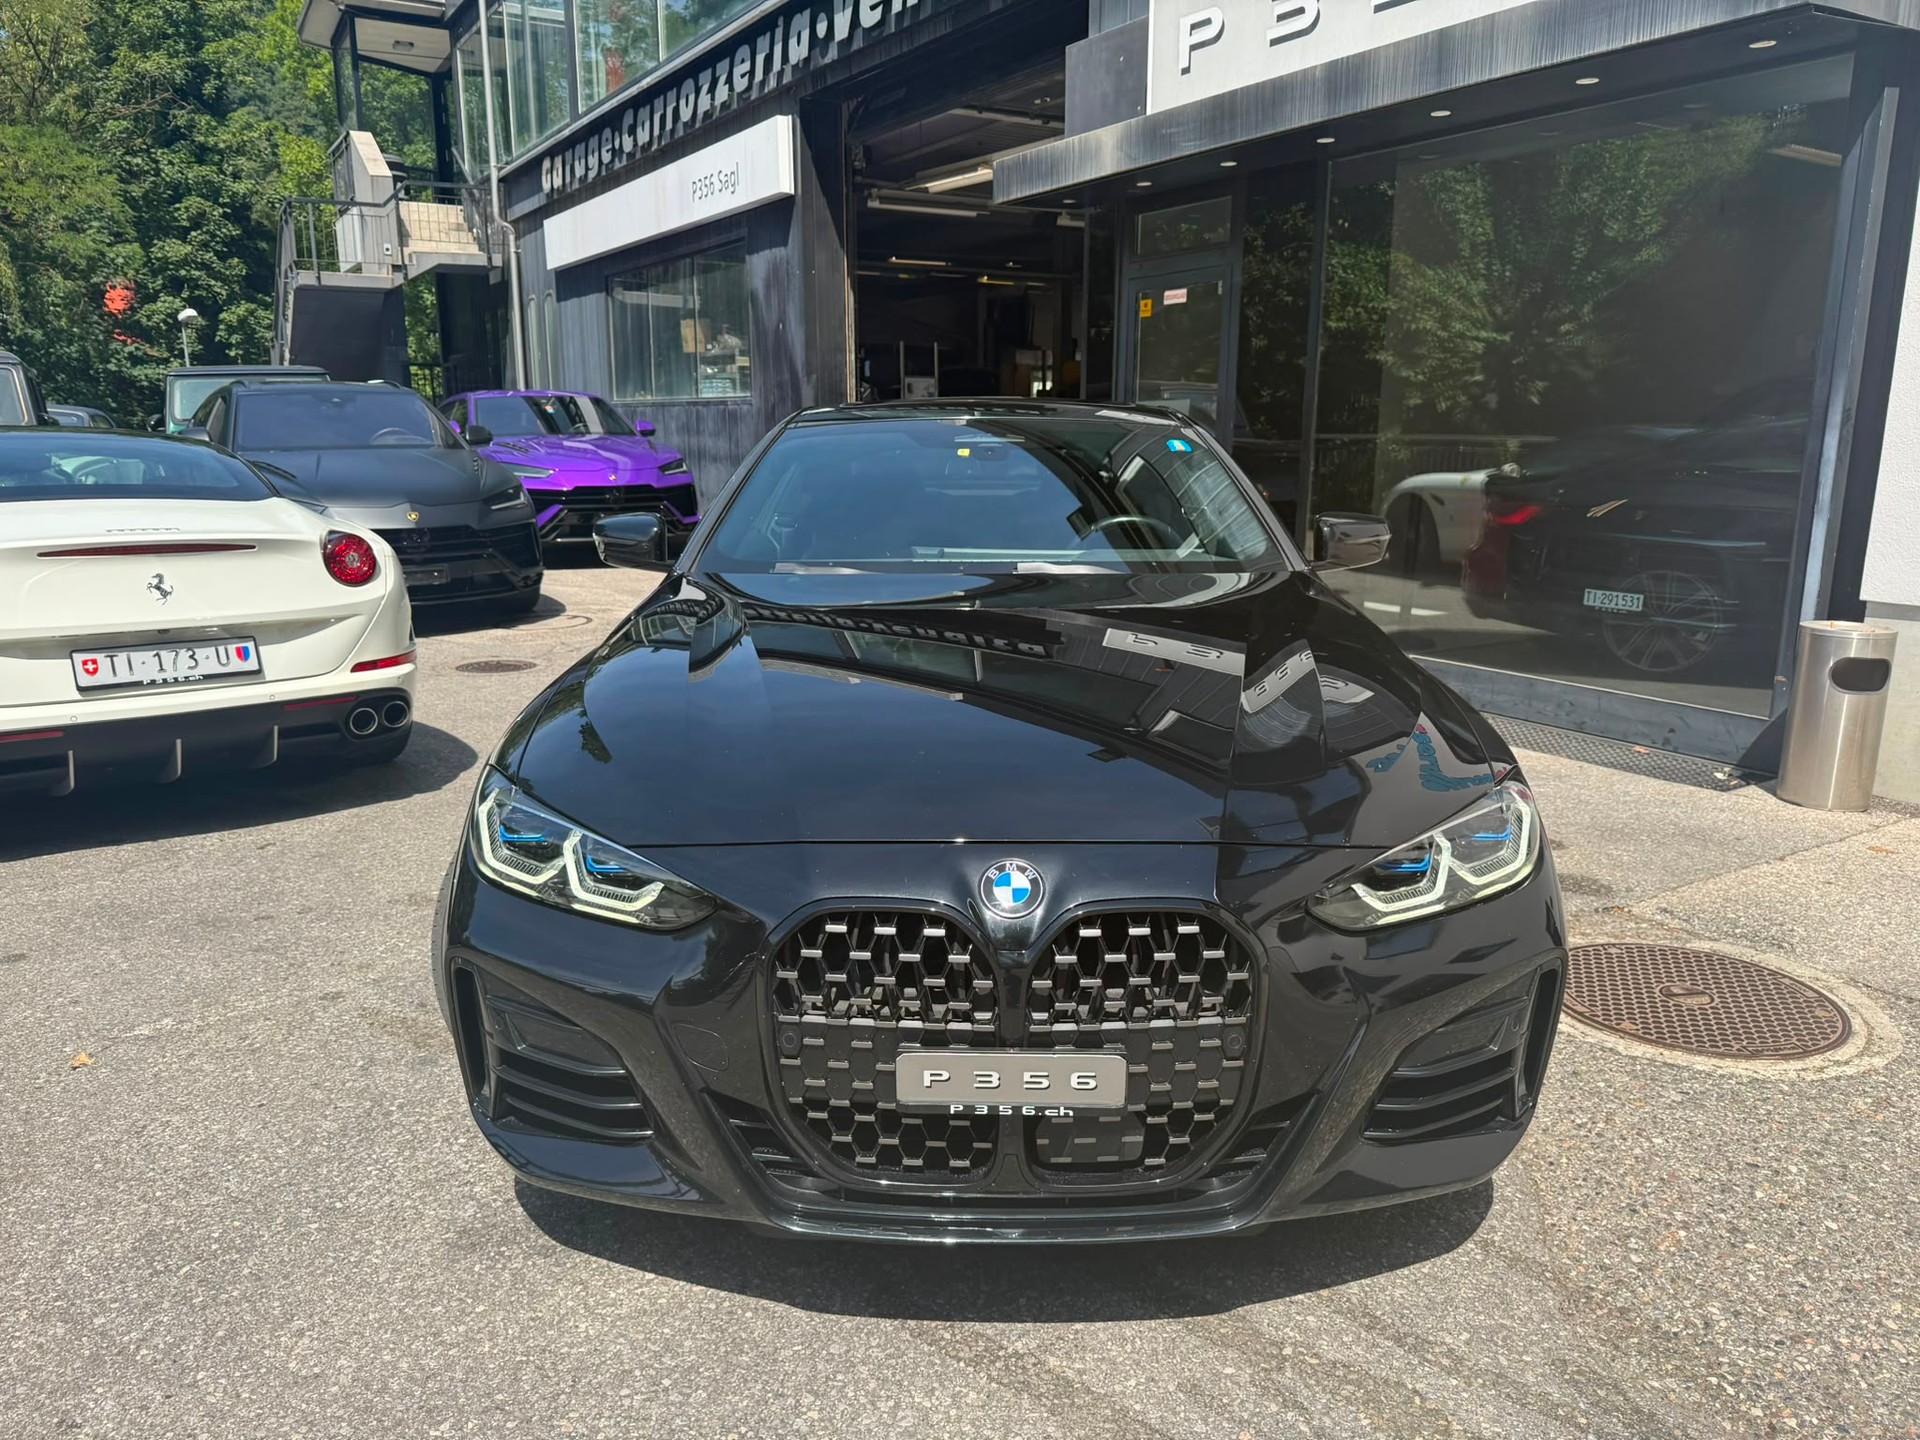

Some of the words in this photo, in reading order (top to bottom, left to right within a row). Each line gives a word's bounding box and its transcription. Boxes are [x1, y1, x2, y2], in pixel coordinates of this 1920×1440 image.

[692, 173, 715, 203] P356
[717, 161, 740, 195] Sagl
[987, 861, 1037, 881] BMW
